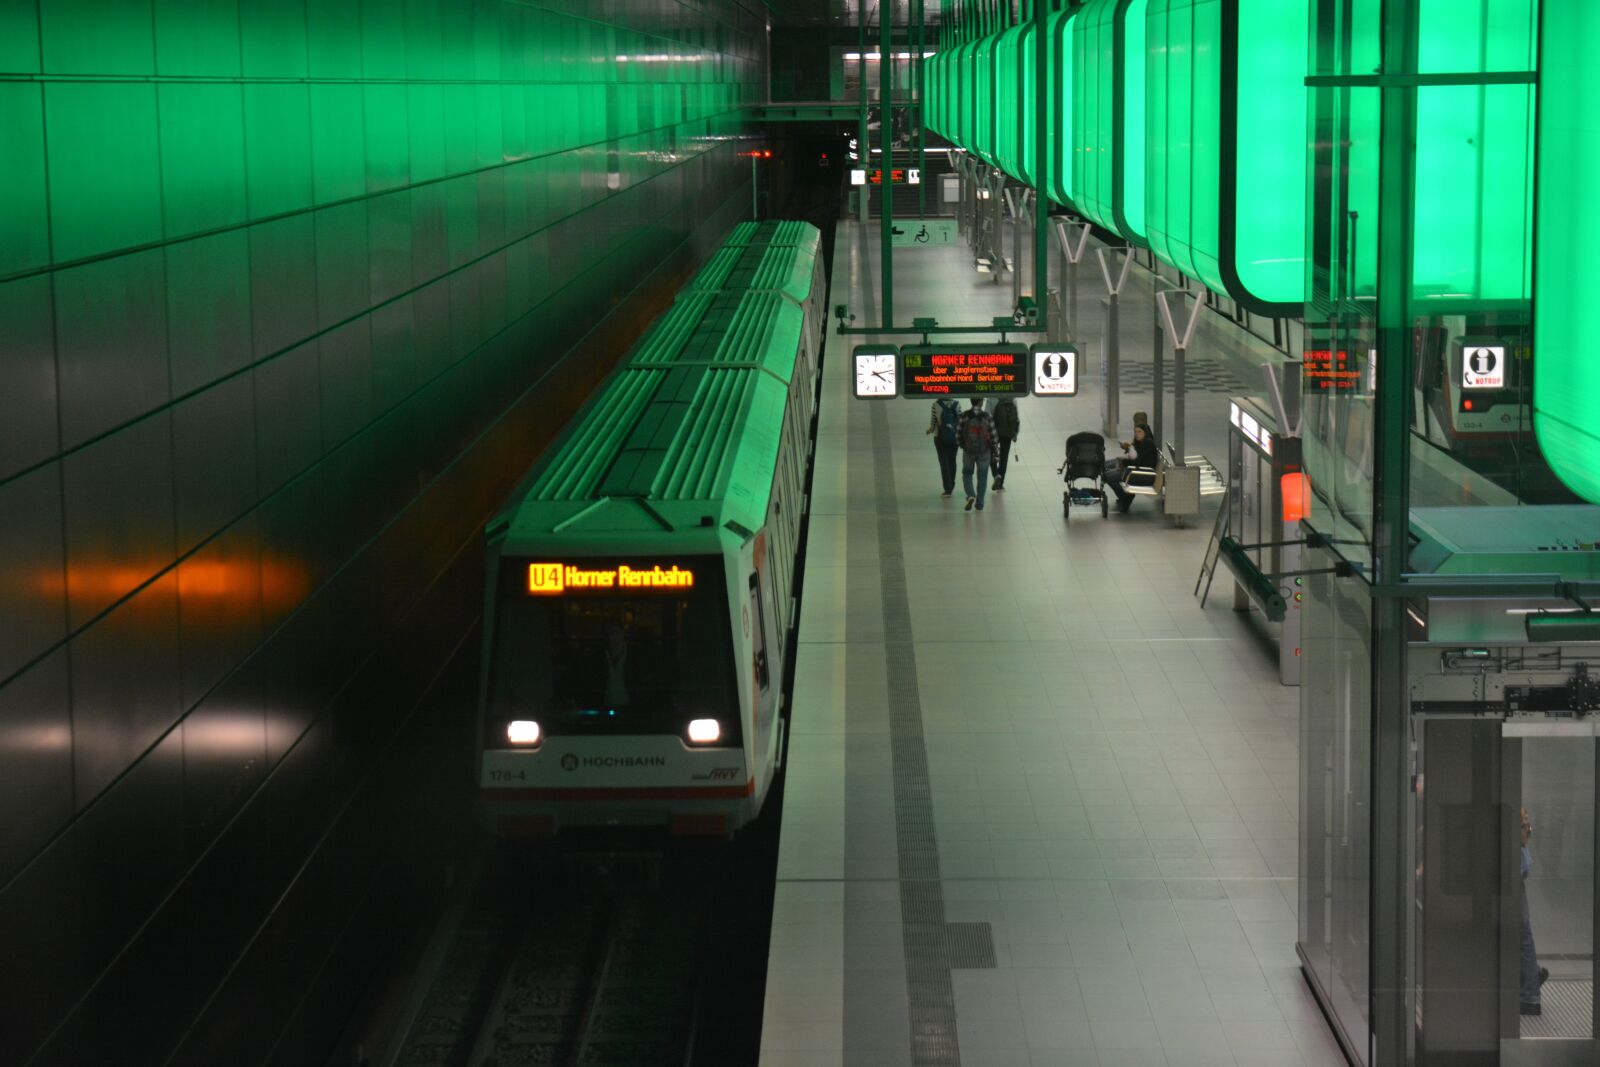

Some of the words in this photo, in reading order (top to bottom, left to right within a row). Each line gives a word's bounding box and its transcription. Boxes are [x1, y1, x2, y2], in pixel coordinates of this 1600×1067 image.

[932, 354, 965, 365] HORNER
[968, 354, 1014, 364] RENNBAHN
[953, 366, 998, 374] Jungfernstieg
[957, 374, 973, 382] Nord
[531, 564, 562, 589] U4
[566, 565, 616, 587] Horner
[619, 565, 693, 587] Rennbahn
[583, 756, 665, 767] HOCHBAHN
